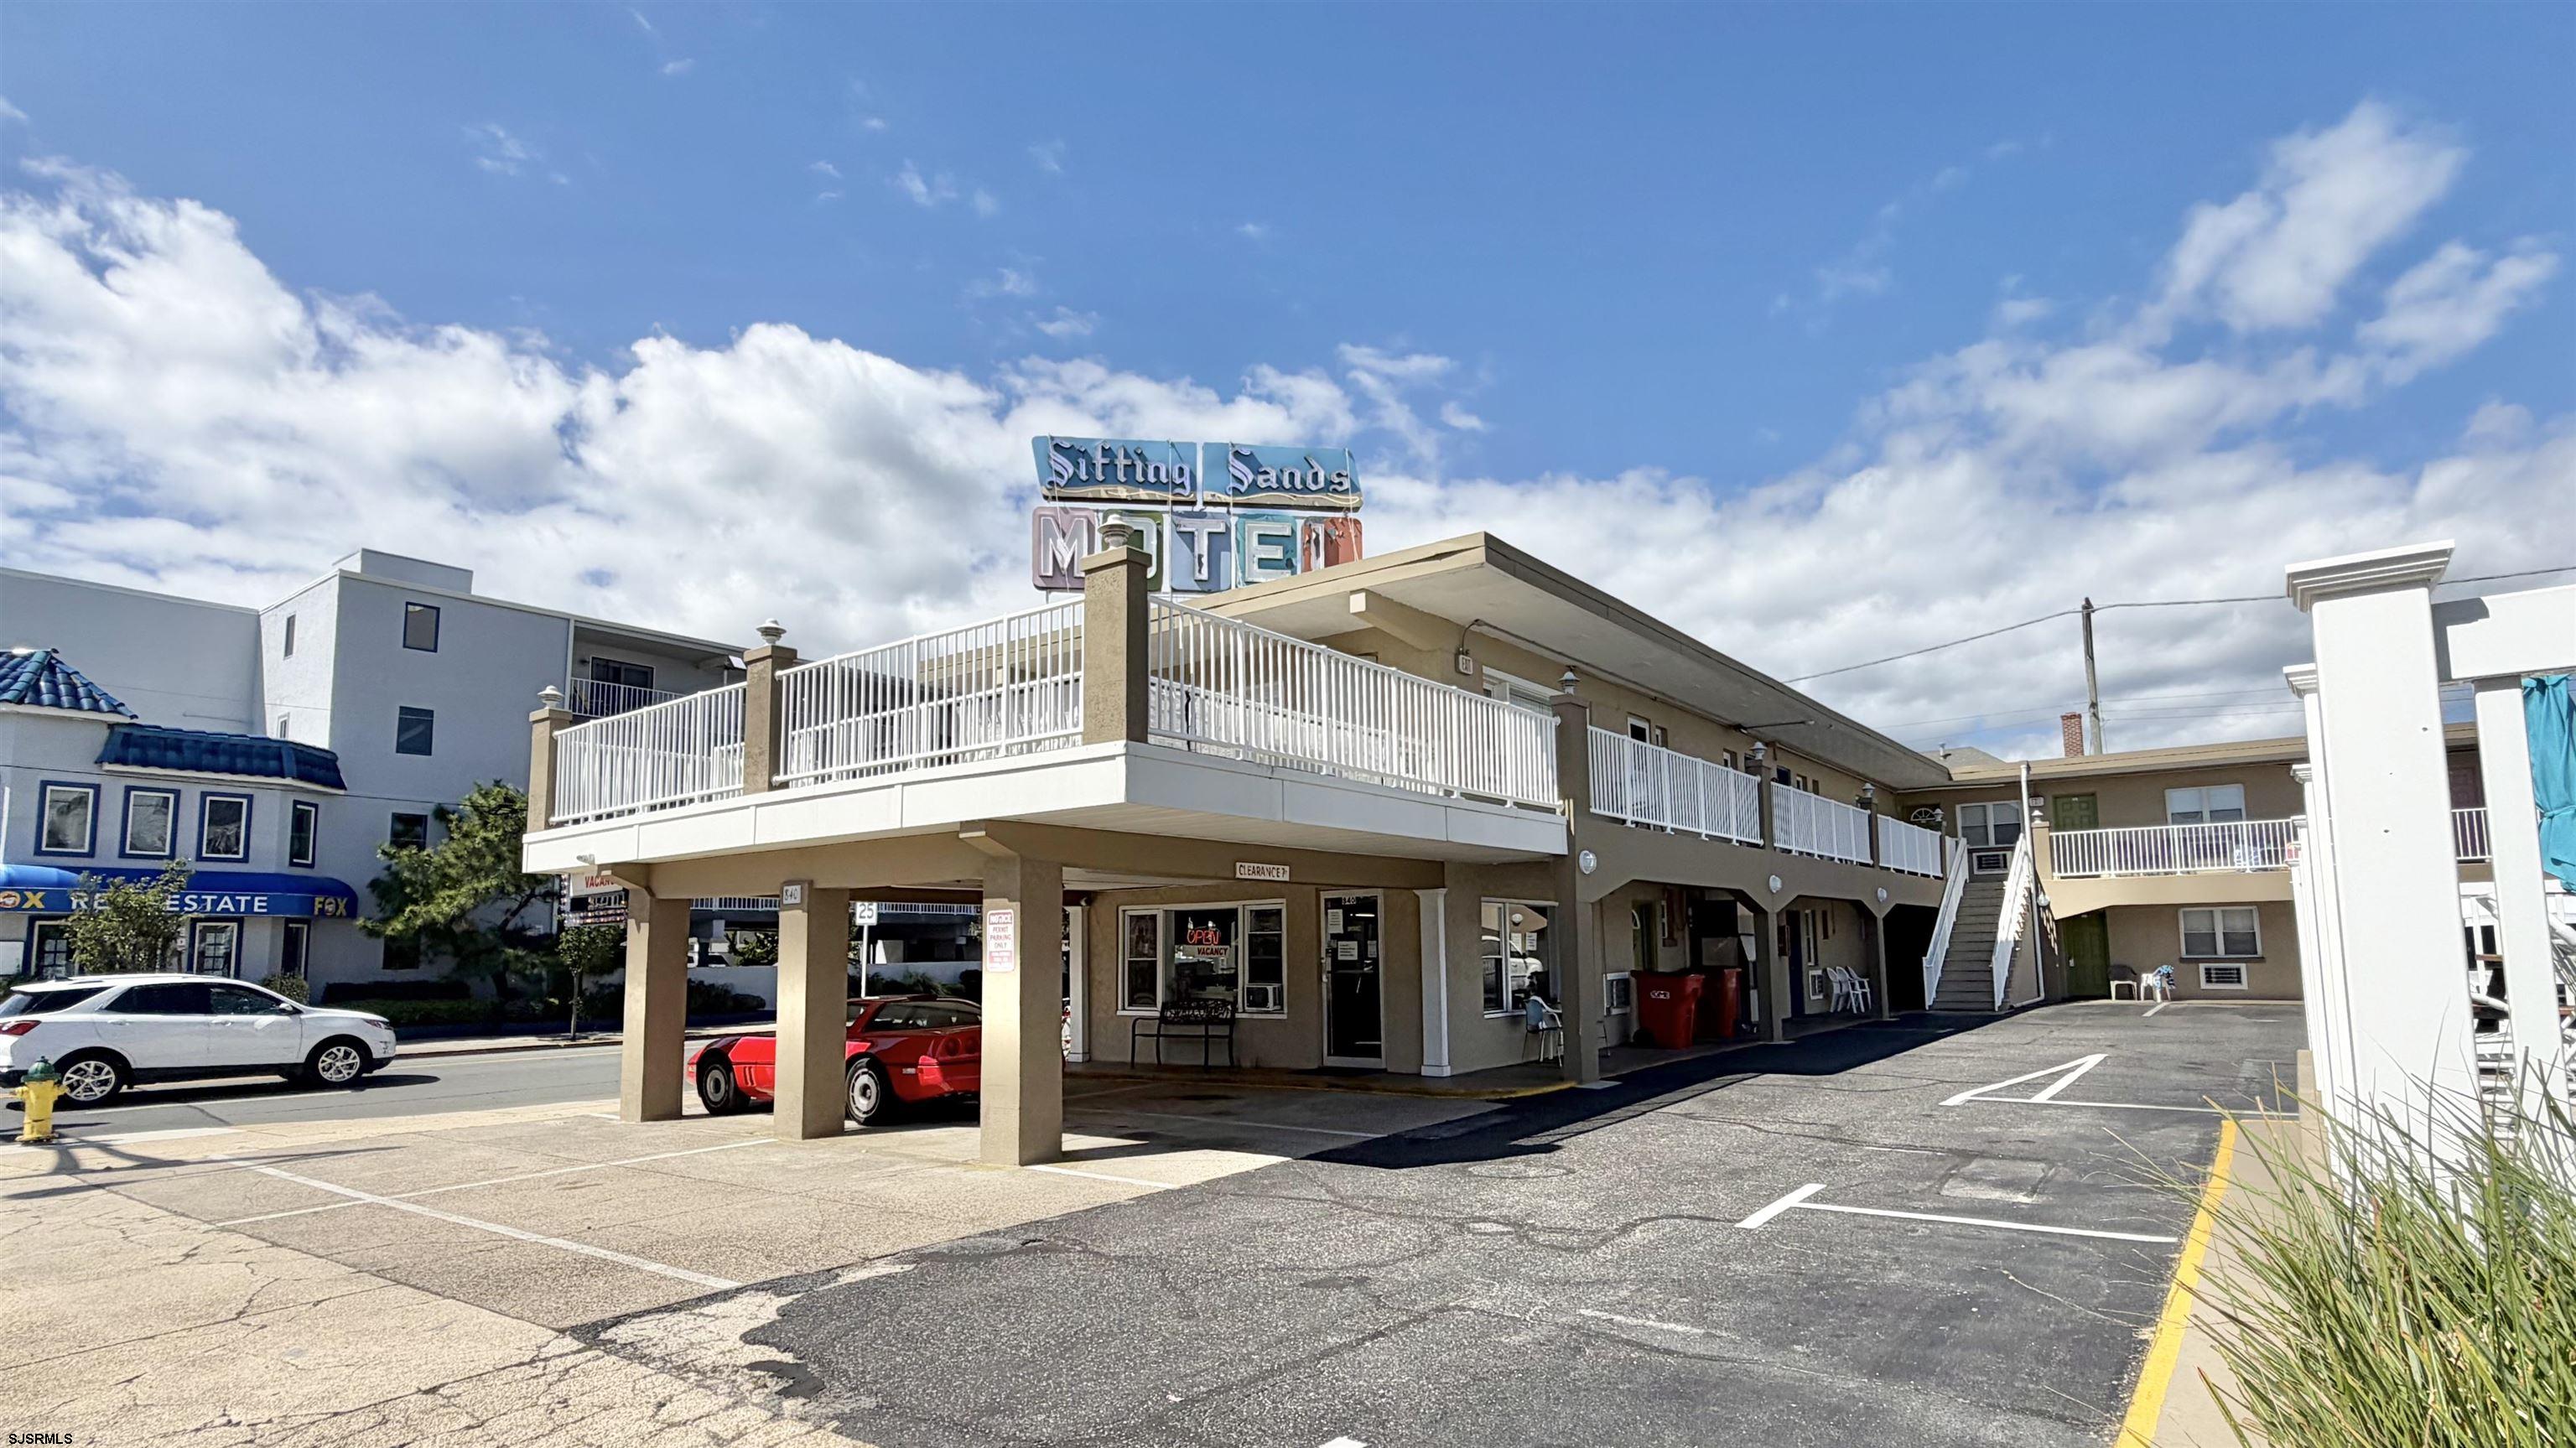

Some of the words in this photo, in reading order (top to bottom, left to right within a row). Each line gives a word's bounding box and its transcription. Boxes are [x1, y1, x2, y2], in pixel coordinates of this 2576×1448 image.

[1046, 439, 1191, 496] Sifting
[1227, 448, 1350, 496] Sands
[1239, 864, 1280, 878] CLEARANCE
[584, 875, 615, 888] VACAN
[784, 887, 799, 900] 840
[167, 895, 268, 912] ESTATE
[314, 896, 348, 916] FOX
[858, 903, 874, 919] 25
[989, 914, 1013, 925] NOTICE
[1187, 929, 1219, 945] OPEN
[1197, 947, 1228, 956] VACANCY
